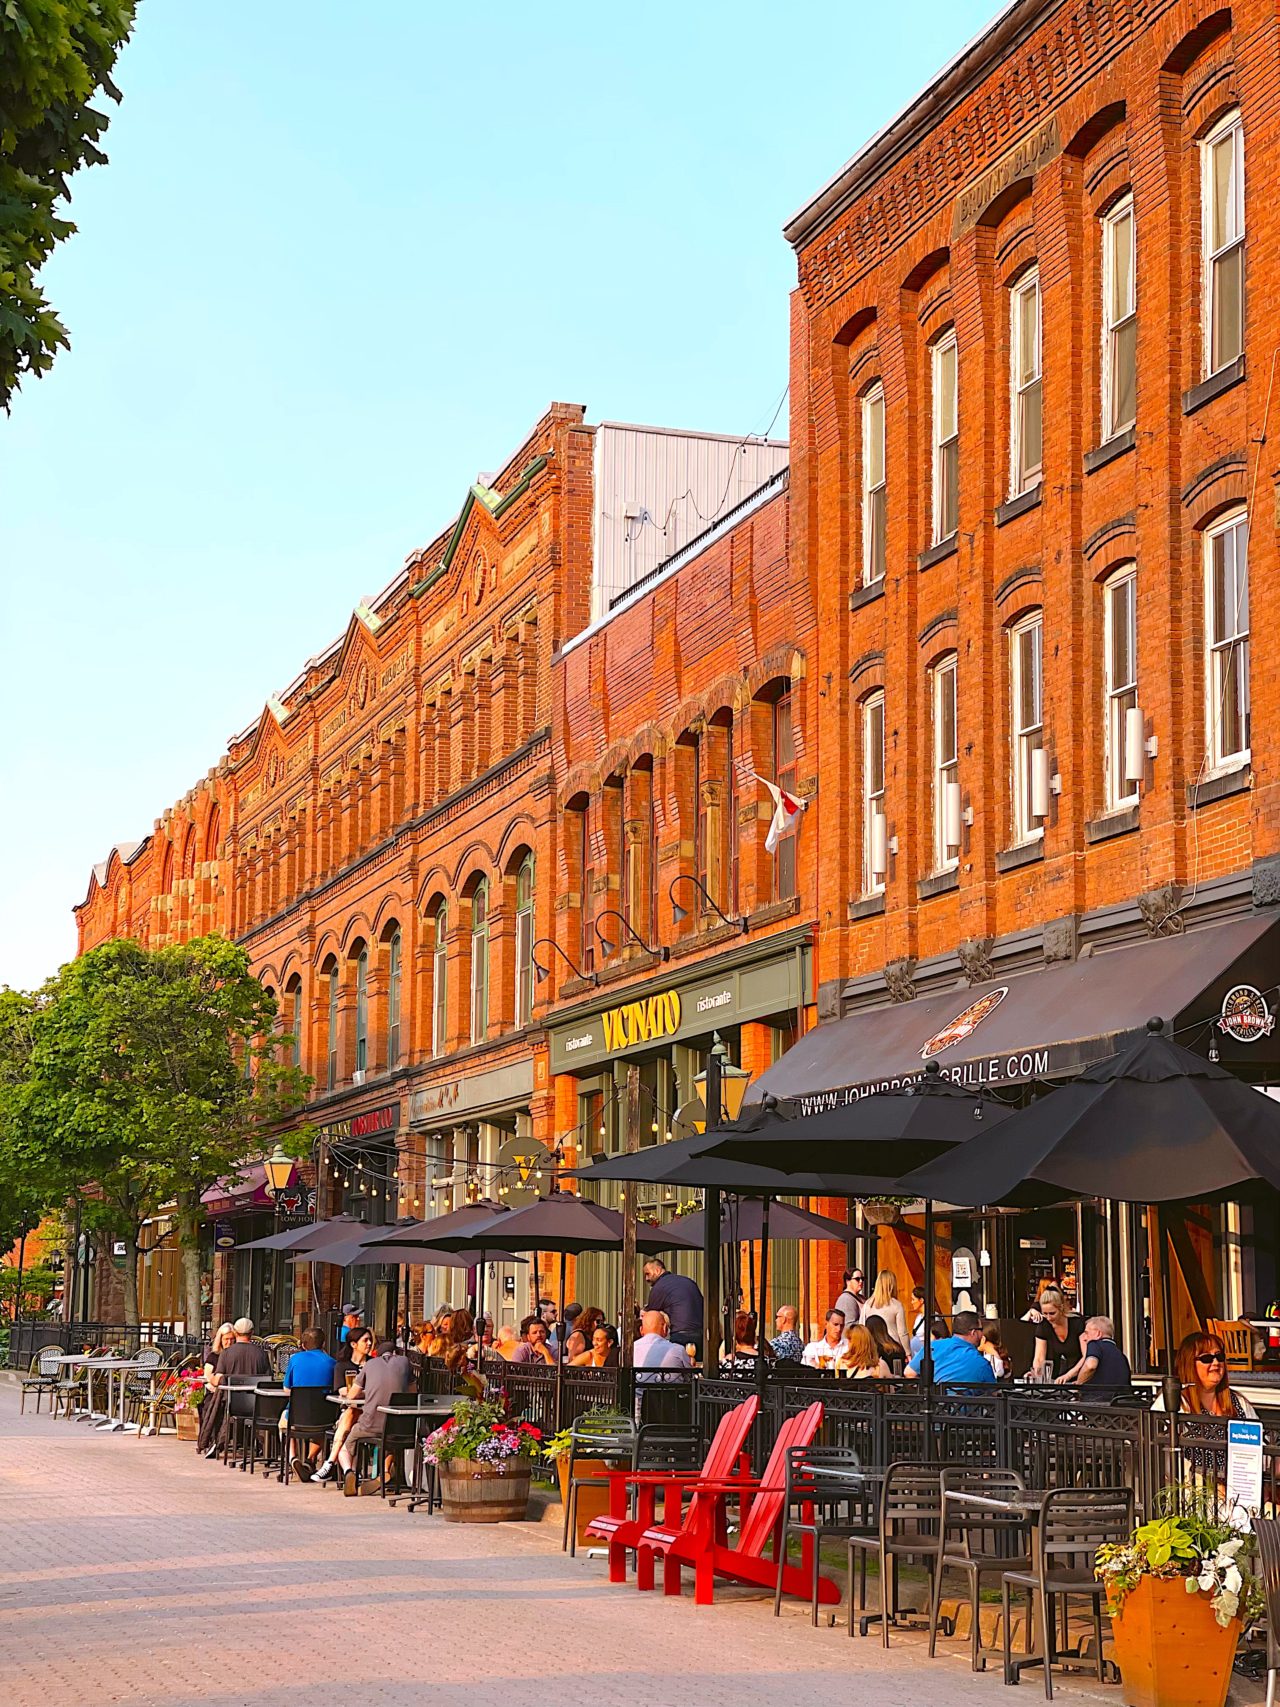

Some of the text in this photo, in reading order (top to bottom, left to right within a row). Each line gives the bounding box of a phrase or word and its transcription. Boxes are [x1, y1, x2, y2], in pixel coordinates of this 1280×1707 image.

[1014, 119, 1055, 176] BLOCK
[601, 989, 682, 1053] VICINATO
[695, 990, 732, 1013] ristorante
[1226, 1015, 1265, 1028] JOHN BROWN
[800, 1050, 1049, 1117] WWW.JOHNGRILLE.COM
